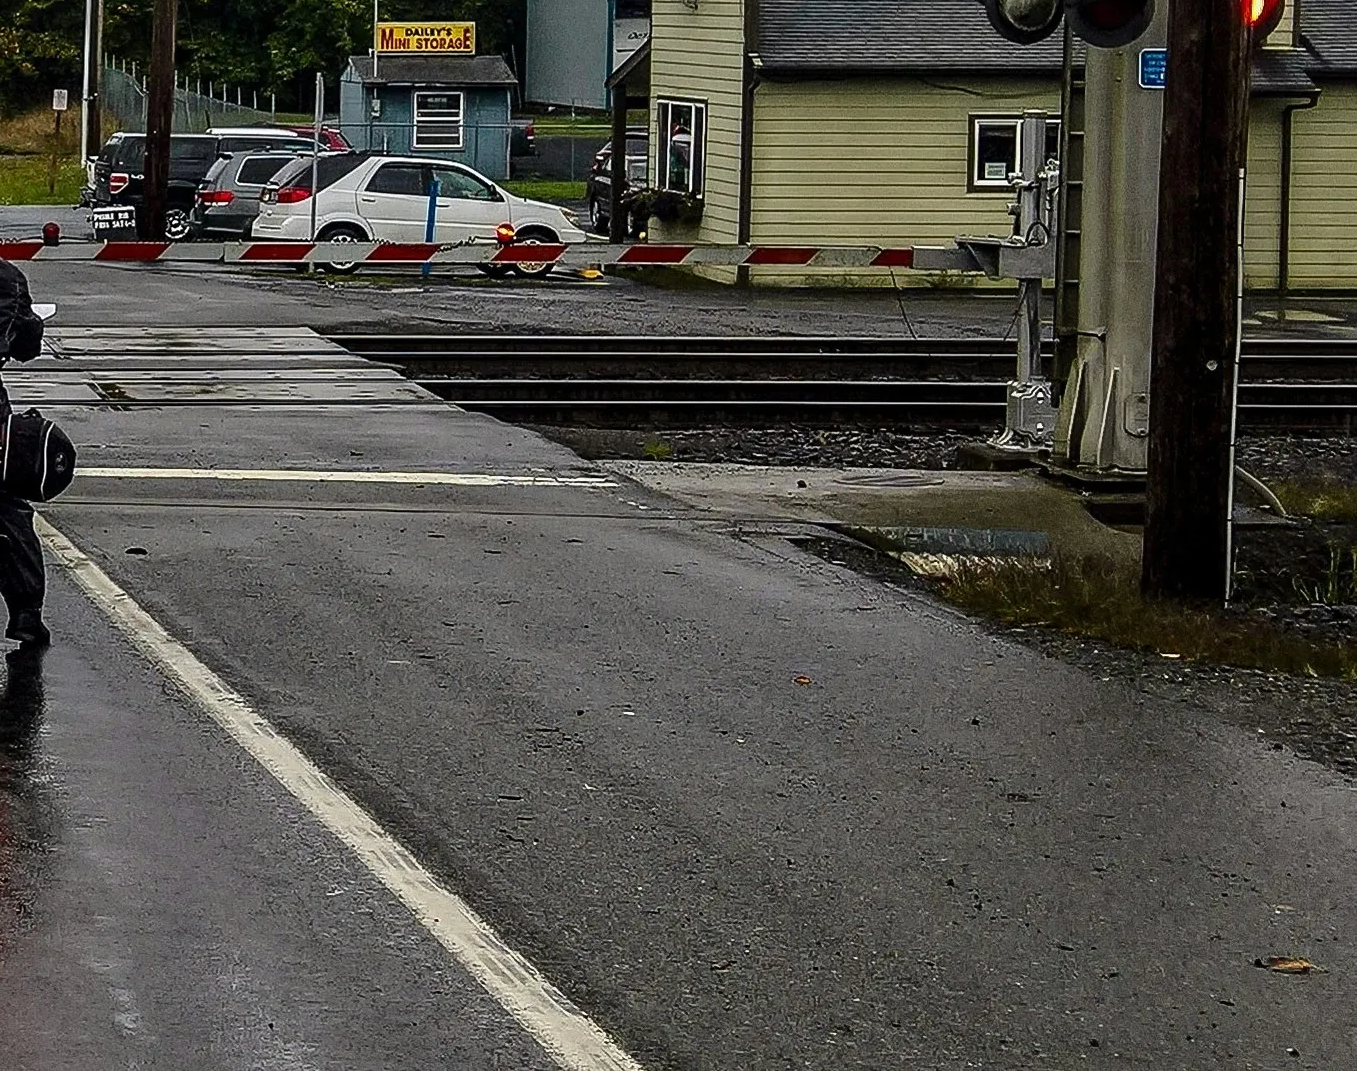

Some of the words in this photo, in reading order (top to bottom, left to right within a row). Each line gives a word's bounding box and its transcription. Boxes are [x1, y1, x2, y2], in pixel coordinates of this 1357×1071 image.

[381, 28, 411, 49] MINI
[415, 27, 471, 49] STORAGE
[405, 27, 452, 37] DAILEY'S
